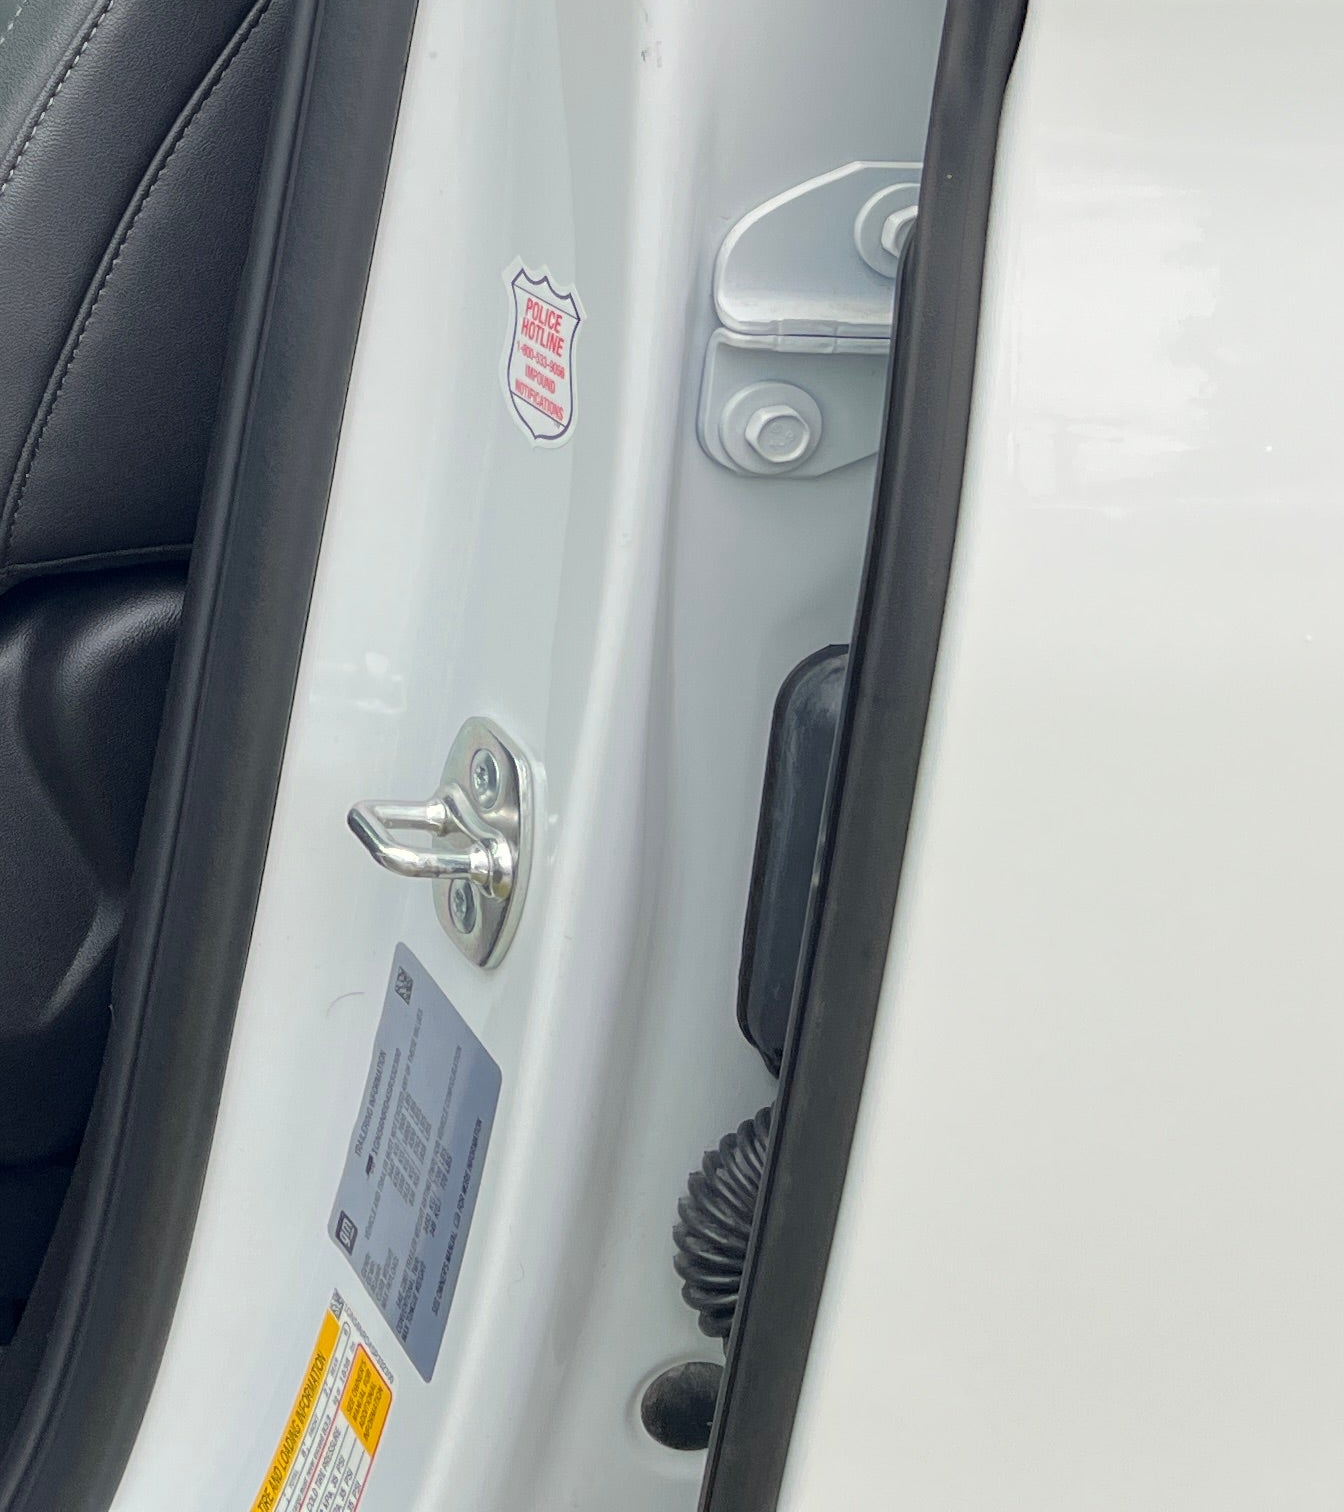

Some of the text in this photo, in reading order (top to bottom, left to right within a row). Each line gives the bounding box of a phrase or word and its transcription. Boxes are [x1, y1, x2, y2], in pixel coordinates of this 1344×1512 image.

[526, 298, 562, 333] POLICE
[521, 317, 565, 357] HOTLINE
[525, 365, 556, 394] IMPOUND
[515, 379, 564, 421] NOTIFICATIONS
[277, 1418, 301, 1470] LOADING
[295, 1350, 326, 1424] INFORMATION
